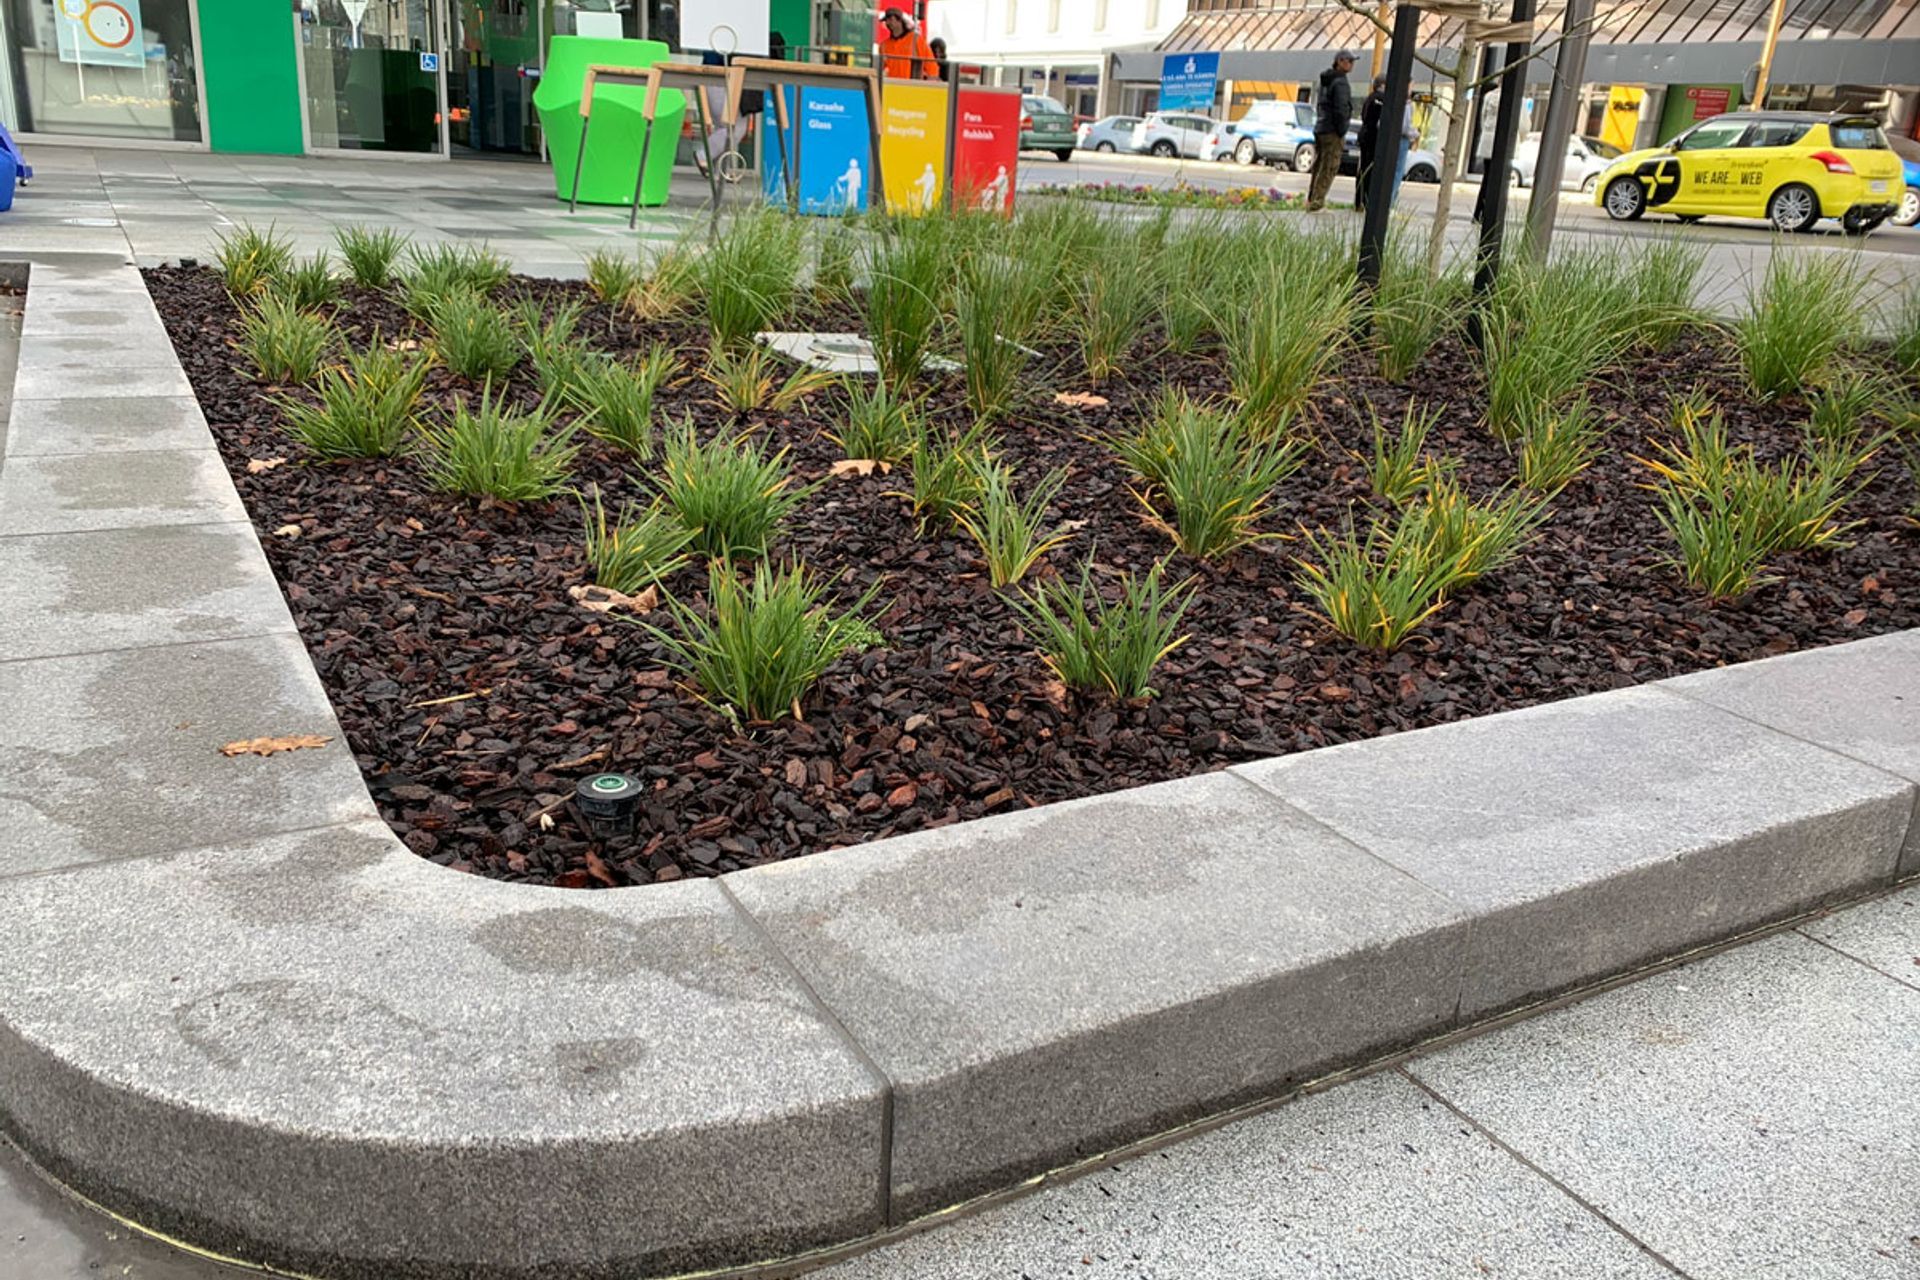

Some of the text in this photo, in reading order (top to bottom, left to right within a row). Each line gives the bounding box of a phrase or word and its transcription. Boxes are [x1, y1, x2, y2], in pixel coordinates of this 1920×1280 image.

[964, 112, 983, 122] Para
[808, 119, 832, 130] Glass
[962, 129, 995, 140] Rubbish
[1694, 170, 1709, 185] WE
[1740, 171, 1763, 186] WEB
